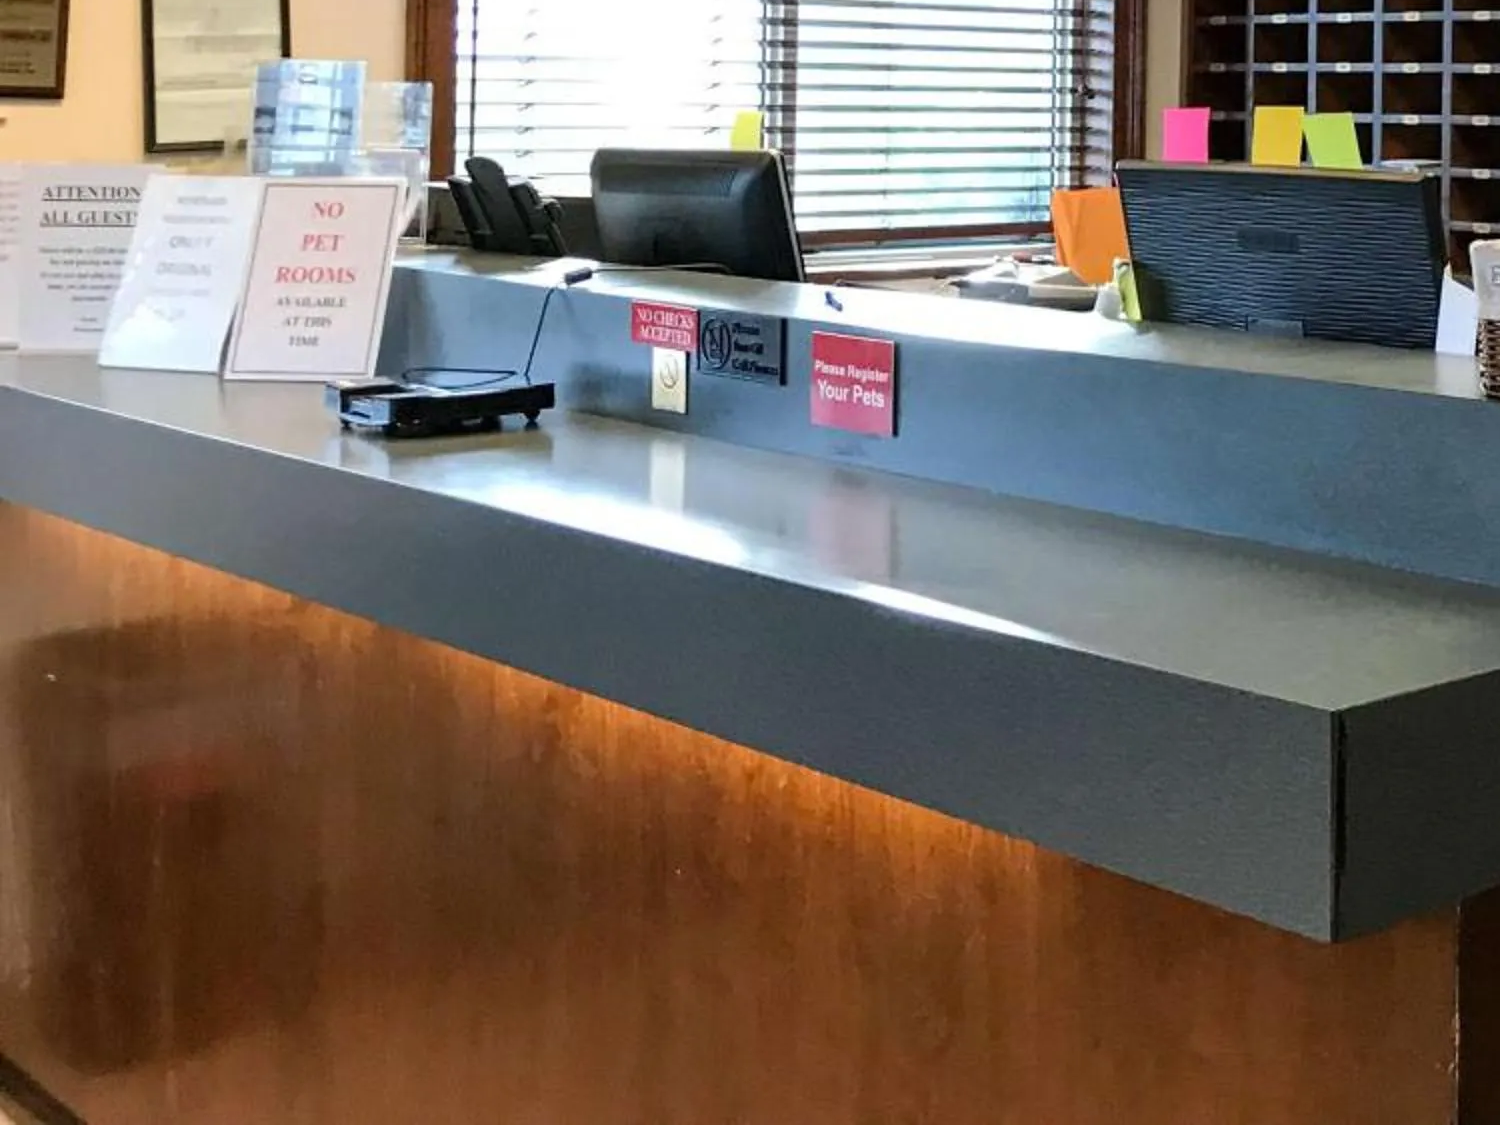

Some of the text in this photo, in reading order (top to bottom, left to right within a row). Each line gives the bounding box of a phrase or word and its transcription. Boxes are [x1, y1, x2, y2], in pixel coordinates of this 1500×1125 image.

[42, 186, 142, 198] ATTENTION
[40, 210, 138, 224] ALL GUEST
[314, 202, 344, 218] NO
[301, 234, 344, 252] PET
[275, 266, 356, 284] ROOMS
[277, 296, 346, 307] AVAILABLE
[304, 317, 332, 327] THIS
[635, 307, 694, 329] NO CHECKS
[289, 336, 319, 347] TIME
[640, 325, 691, 344] ACCEPTED
[815, 359, 888, 383] Please Register
[817, 378, 885, 408] Your Pets
